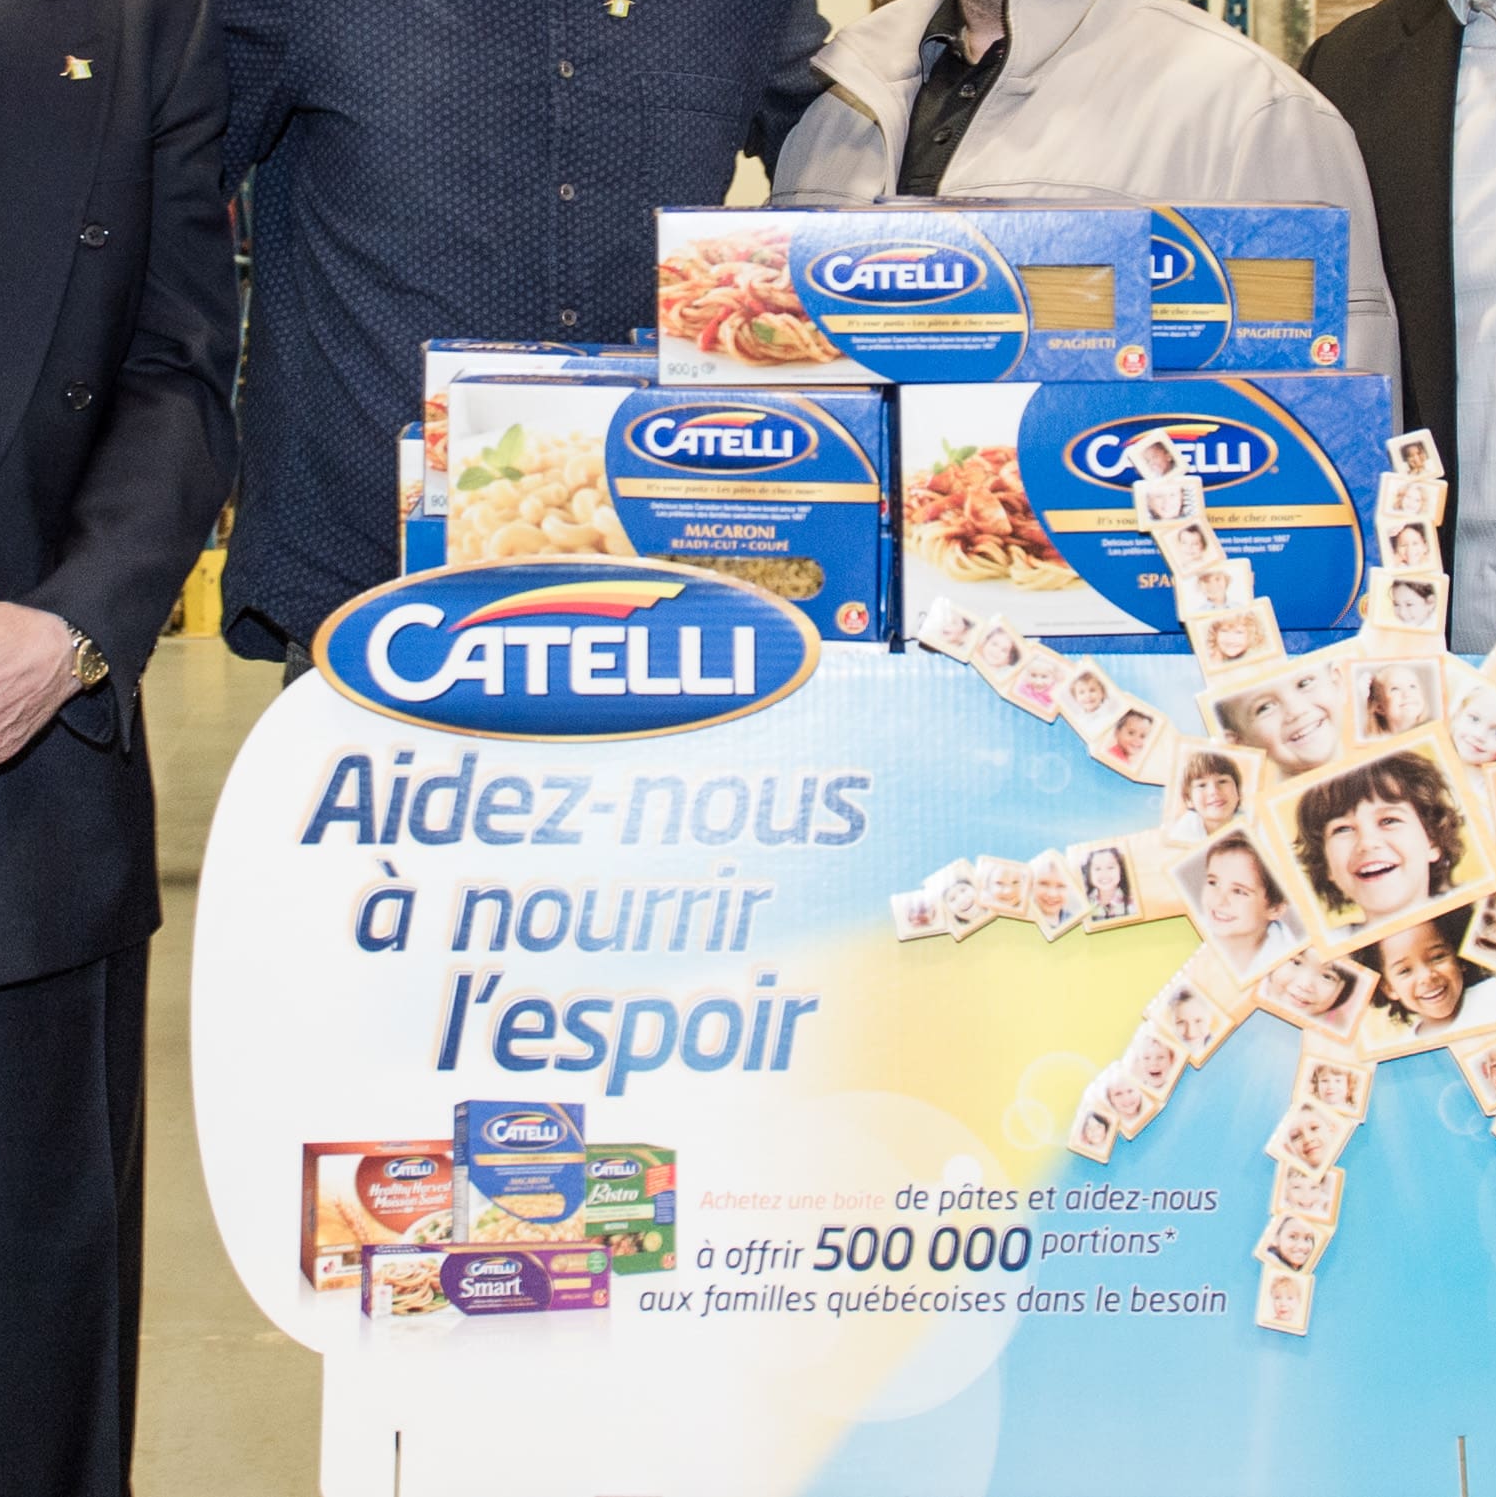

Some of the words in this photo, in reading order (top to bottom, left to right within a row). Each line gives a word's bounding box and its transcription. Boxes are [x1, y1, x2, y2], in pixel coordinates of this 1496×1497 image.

[824, 255, 964, 292] CATELLI
[1048, 338, 1116, 351] SPAGHETTI
[1236, 328, 1313, 339] SPAGHETTINI
[644, 417, 794, 458] CATELLI
[1086, 434, 1251, 479] CELLI
[685, 524, 775, 539] MACARONI
[367, 602, 756, 702] CATELLI
[300, 751, 872, 845] Aidez-nous
[355, 859, 417, 952] à
[451, 865, 773, 952] nourrir
[437, 971, 819, 1096] l'espoir
[492, 1120, 558, 1142] CATELLI
[590, 1161, 636, 1177] CATELLI
[587, 1183, 639, 1205] Bistro
[699, 1190, 782, 1211] Achetez
[789, 1194, 834, 1211] une
[895, 1184, 929, 1210] de
[938, 1184, 1019, 1216] pâtes
[1028, 1186, 1057, 1211] et
[1065, 1184, 1218, 1211] aidez-nous
[697, 1239, 714, 1269] à
[725, 1239, 805, 1275] offrir
[813, 1224, 915, 1272] 500
[928, 1224, 1033, 1272] 000
[459, 1277, 522, 1298] Smart
[639, 1290, 693, 1312] aux
[700, 1284, 817, 1316] familles
[827, 1285, 1007, 1318] québécoises
[1016, 1285, 1086, 1312] dans
[1096, 1285, 1121, 1312] le
[1130, 1285, 1227, 1312] besoin
